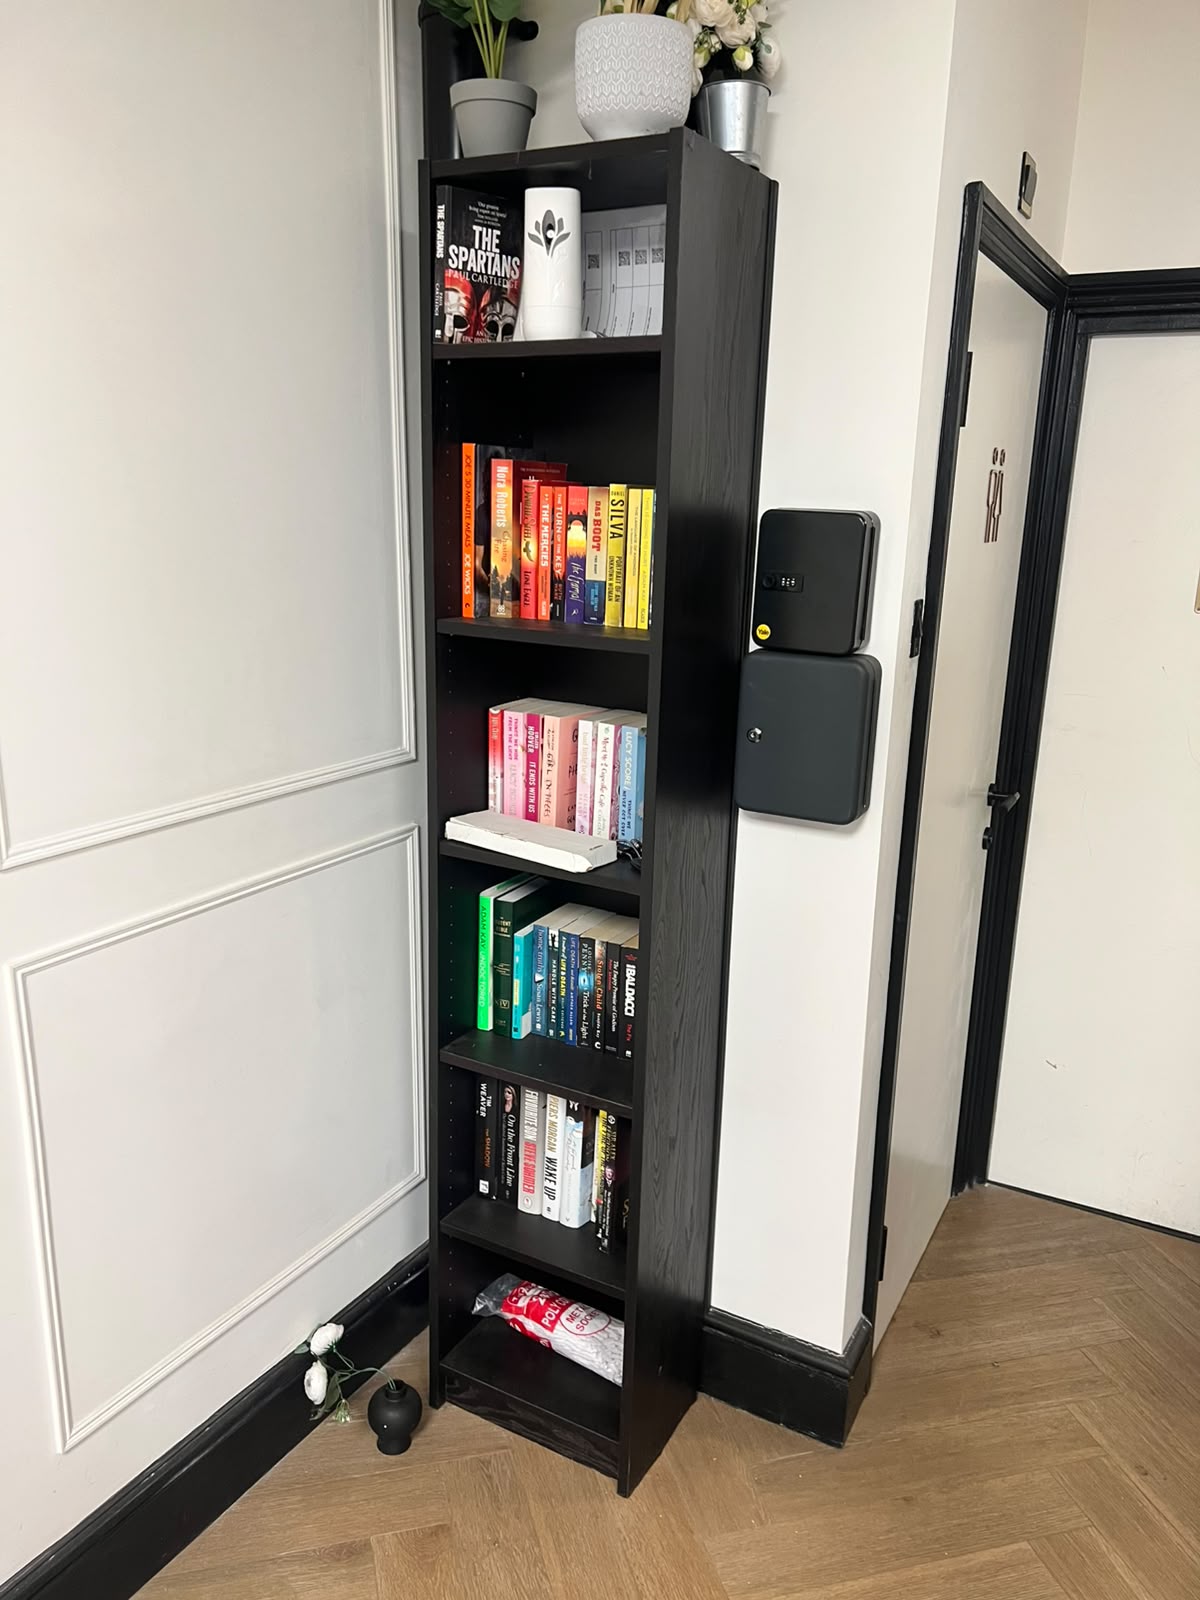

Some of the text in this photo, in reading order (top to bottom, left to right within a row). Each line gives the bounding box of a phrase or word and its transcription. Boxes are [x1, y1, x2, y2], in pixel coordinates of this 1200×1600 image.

[436, 204, 445, 258] THE SPARTANS
[472, 225, 501, 253] THE
[448, 244, 520, 280] SPARTANS
[448, 268, 519, 289] PAUL CARTLEDGE
[496, 466, 508, 527] Nora Roberts
[592, 518, 601, 551] BOOT
[610, 499, 624, 539] SILVA
[540, 525, 549, 566] MERCIES
[557, 534, 561, 543] OF
[615, 594, 621, 602] AN
[601, 737, 610, 753] Meet
[528, 804, 535, 813] US
[537, 929, 545, 950] home
[624, 969, 636, 1017] BALDACCI
[524, 1089, 539, 1142] FAVOURITE SON
[546, 1094, 559, 1153] PIERS MORGAN
[506, 1114, 516, 1186] On the Front Line
[523, 1141, 536, 1163] STEVE
[544, 1156, 558, 1201] WAKE UP
[541, 1301, 561, 1327] POLY
